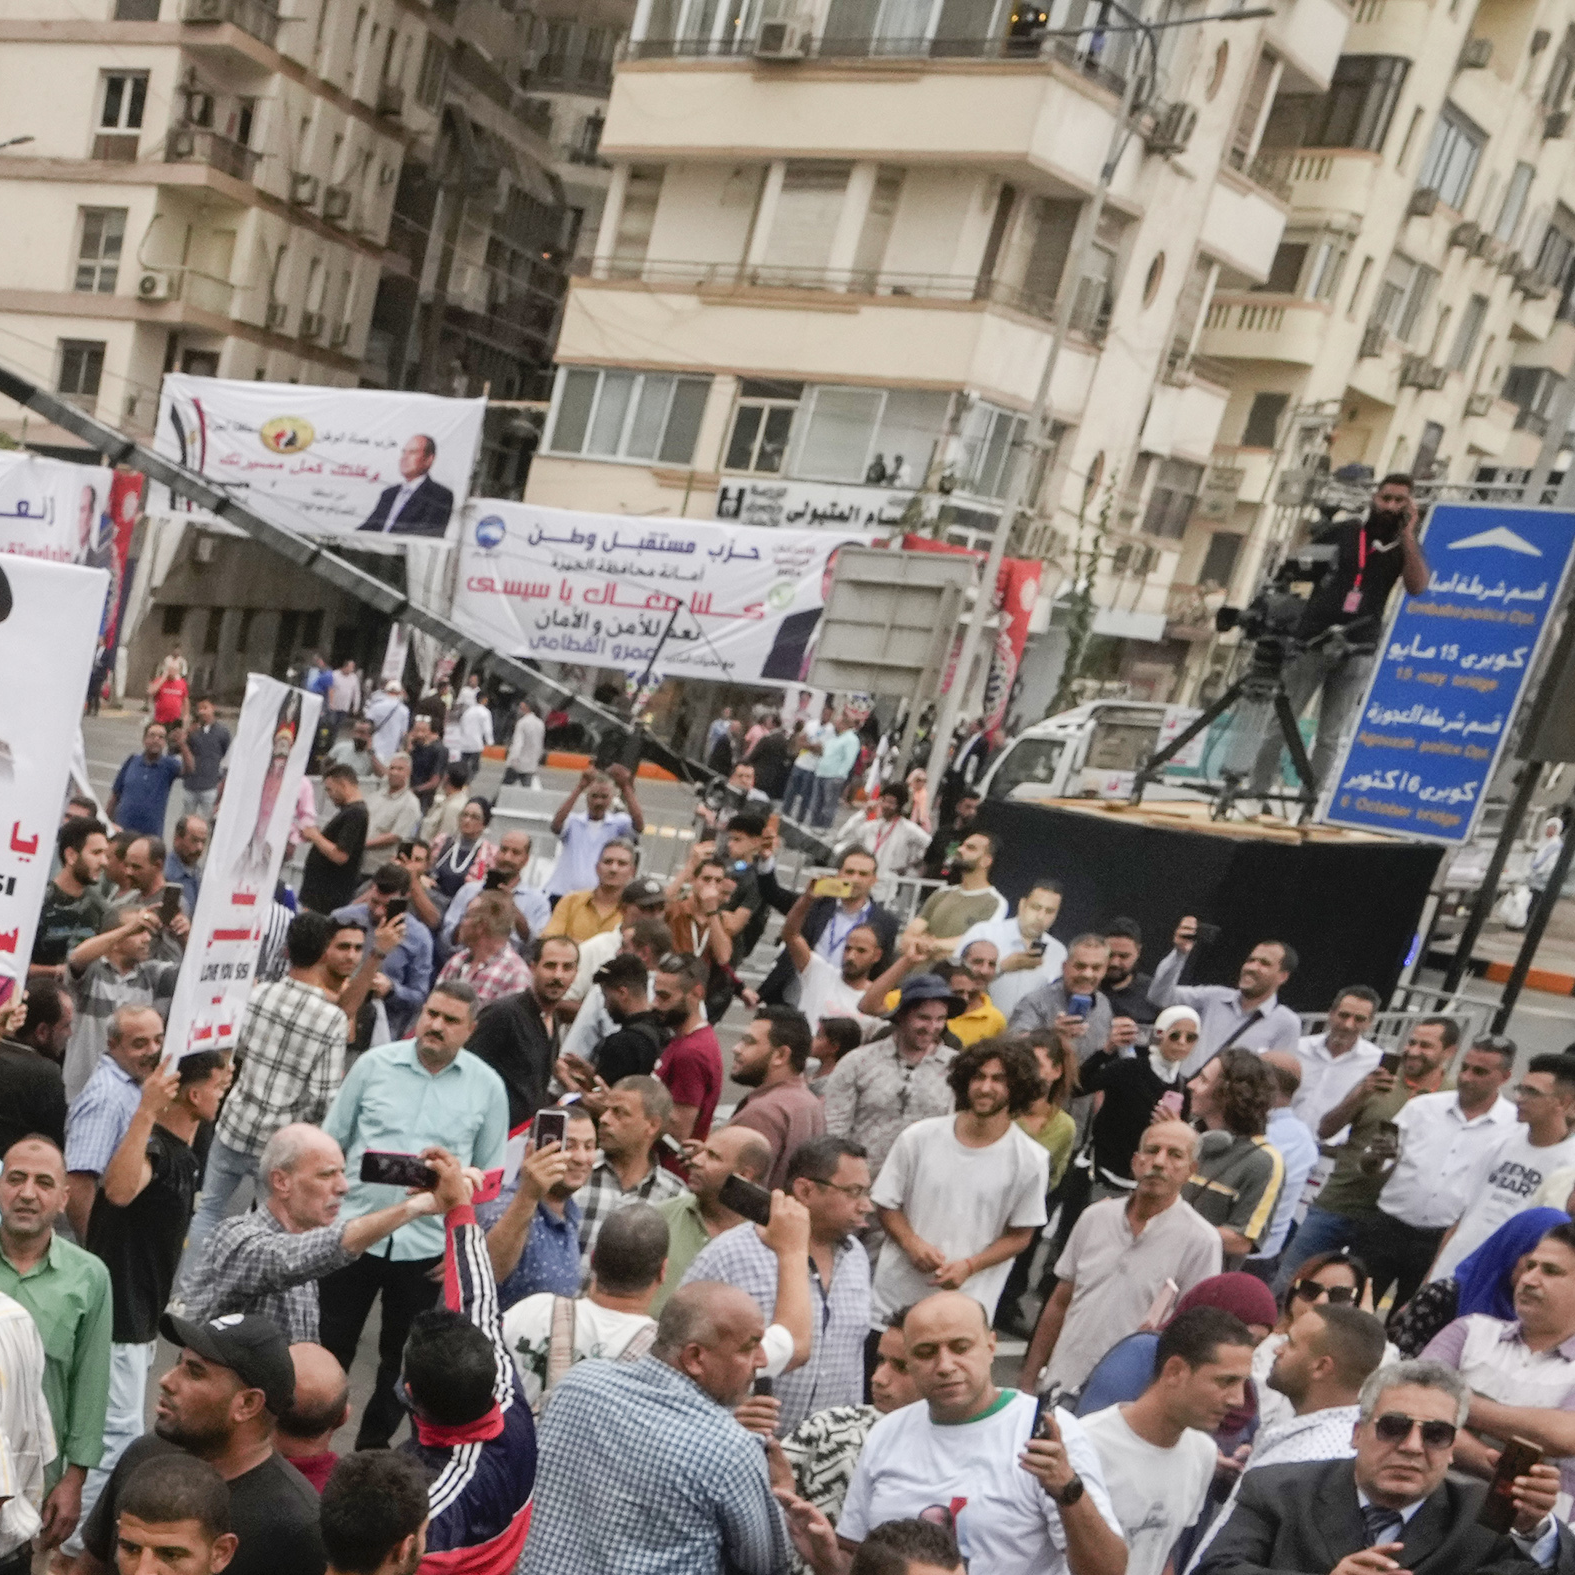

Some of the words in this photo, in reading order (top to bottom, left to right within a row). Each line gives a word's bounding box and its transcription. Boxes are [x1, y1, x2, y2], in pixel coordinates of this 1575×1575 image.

[527, 523, 597, 552] وطن
[601, 530, 697, 555] مستقبل
[707, 538, 761, 564] حزب
[1387, 633, 1438, 662] مايو
[8, 820, 40, 863] يا
